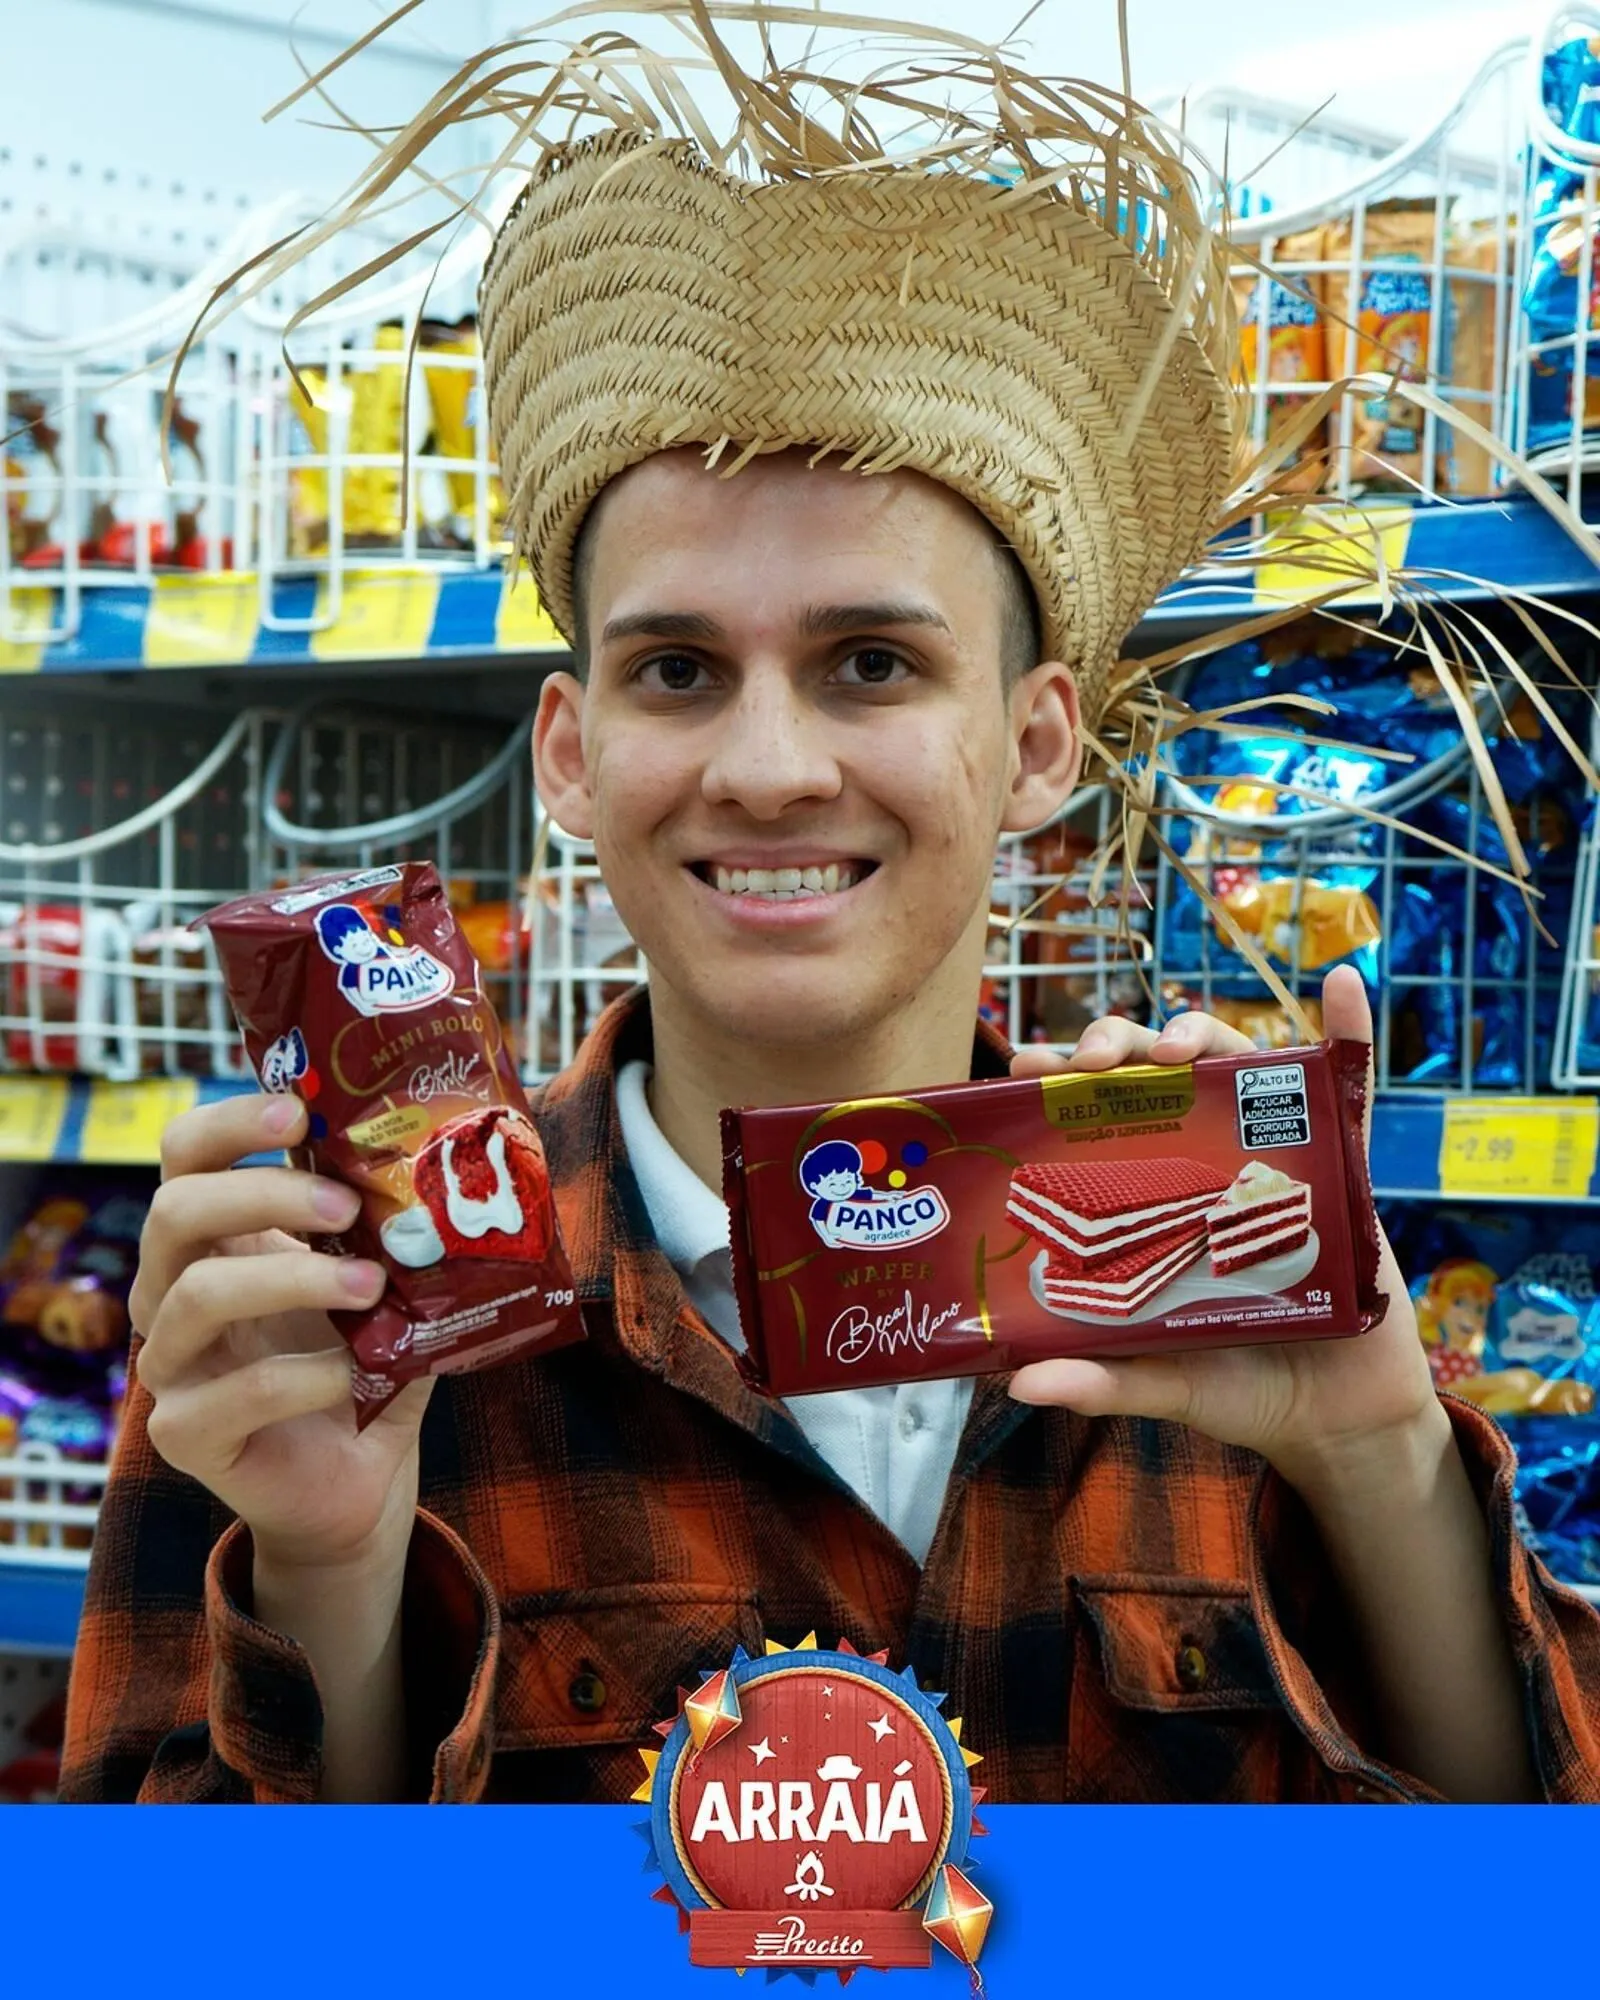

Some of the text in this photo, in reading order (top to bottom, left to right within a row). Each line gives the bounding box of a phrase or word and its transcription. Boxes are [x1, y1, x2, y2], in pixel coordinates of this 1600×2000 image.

[371, 1014, 484, 1070] MINI BOLO
[1259, 1073, 1299, 1087] ALTO EM
[1094, 1083, 1144, 1100] SABOR
[1058, 1094, 1185, 1121] RED VELVET
[1244, 1105, 1303, 1120] ADICIONADO
[1251, 1120, 1299, 1134] GORDURA
[1251, 1131, 1302, 1146] SATURADA
[835, 1197, 936, 1231] PANCO
[864, 1227, 911, 1244] agradece
[837, 1261, 934, 1289] WAFER
[544, 1289, 574, 1308] 70g
[1305, 1289, 1322, 1303] 112
[826, 1304, 906, 1364] Beca
